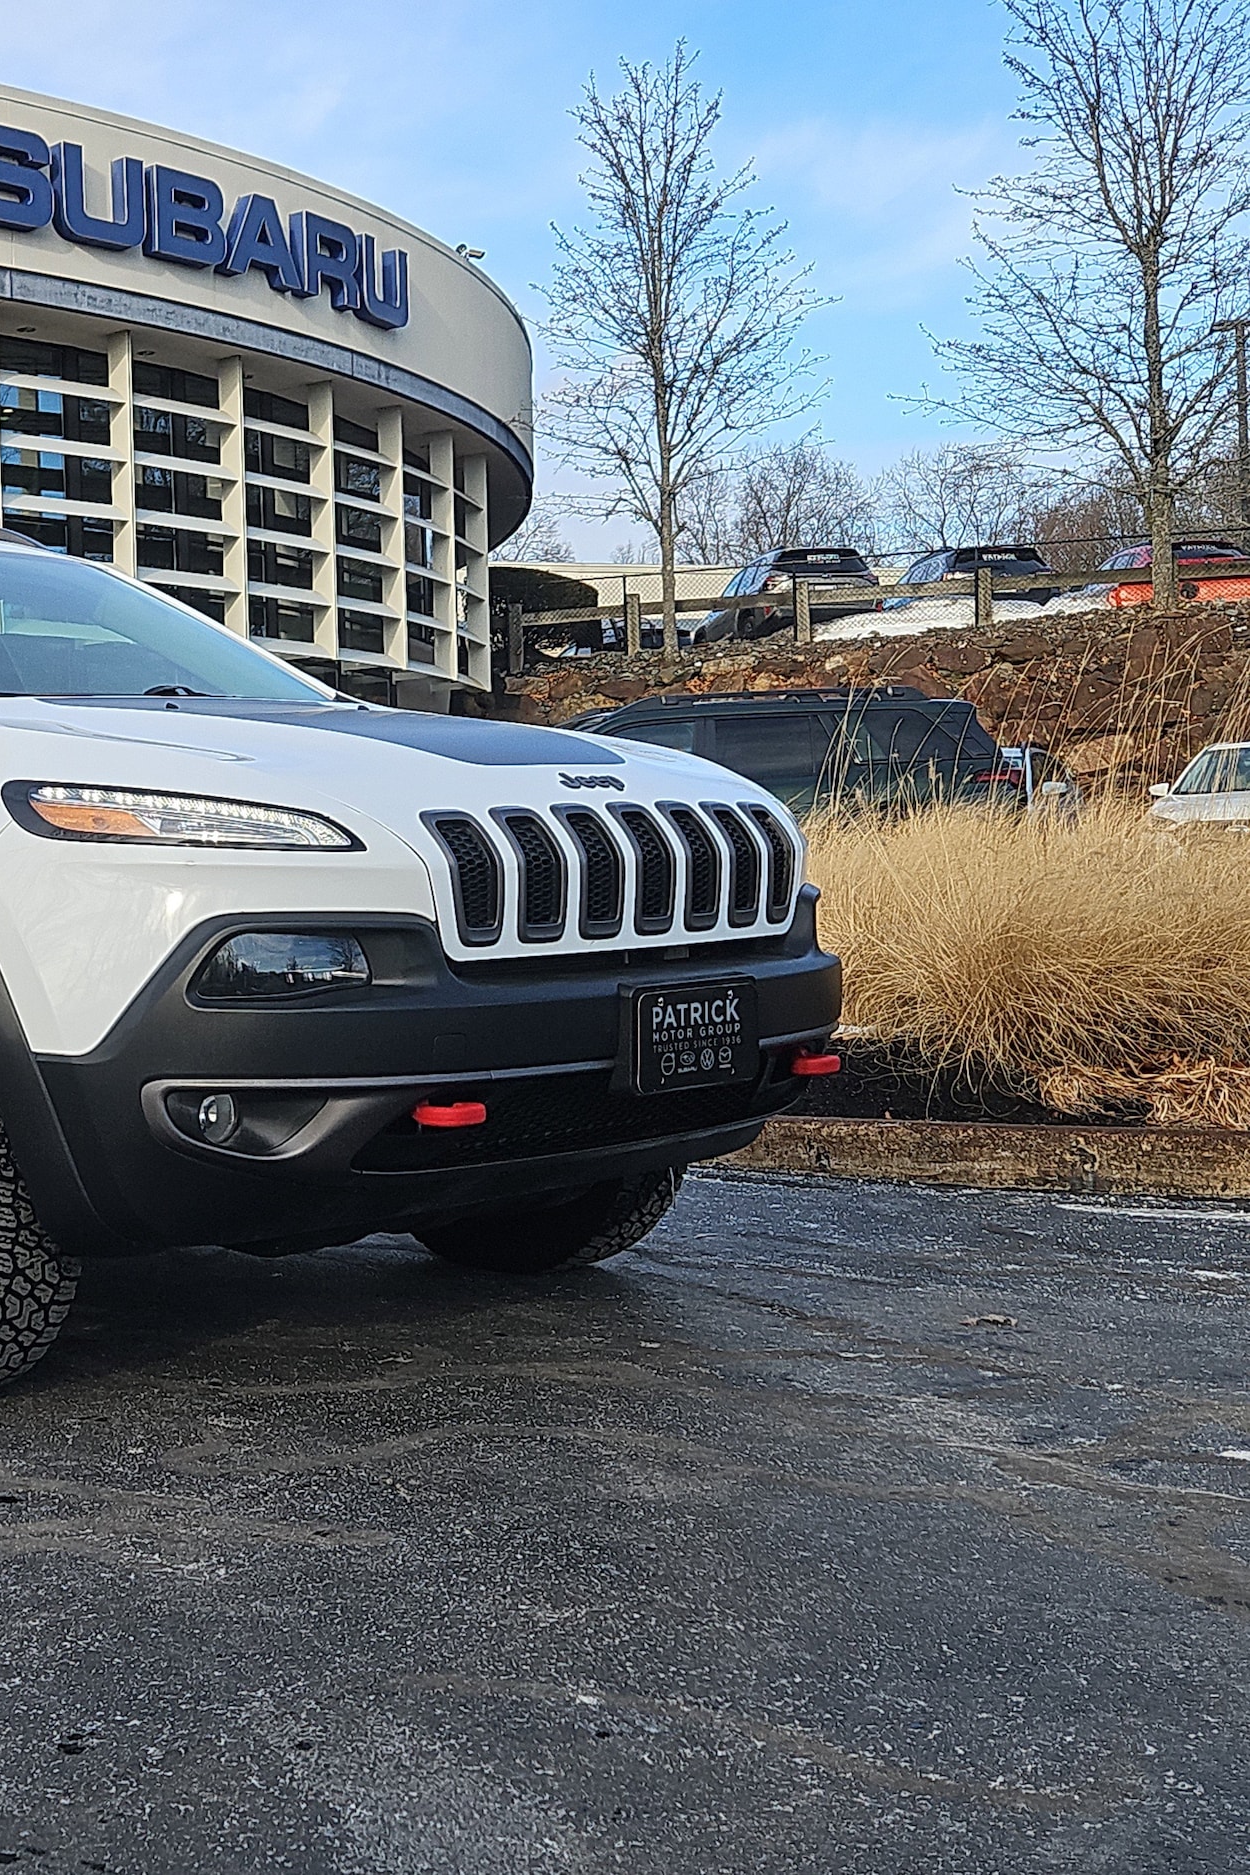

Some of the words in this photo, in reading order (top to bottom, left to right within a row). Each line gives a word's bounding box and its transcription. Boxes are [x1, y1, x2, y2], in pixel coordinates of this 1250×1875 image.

[558, 772, 626, 792] Jeep
[652, 998, 740, 1030] PATRICK
[653, 1028, 693, 1043] MOTOR
[699, 1022, 741, 1038] GROUP
[653, 1042, 690, 1053] TRUSTED
[693, 1037, 718, 1049] SINCE
[721, 1034, 742, 1046] 1936
